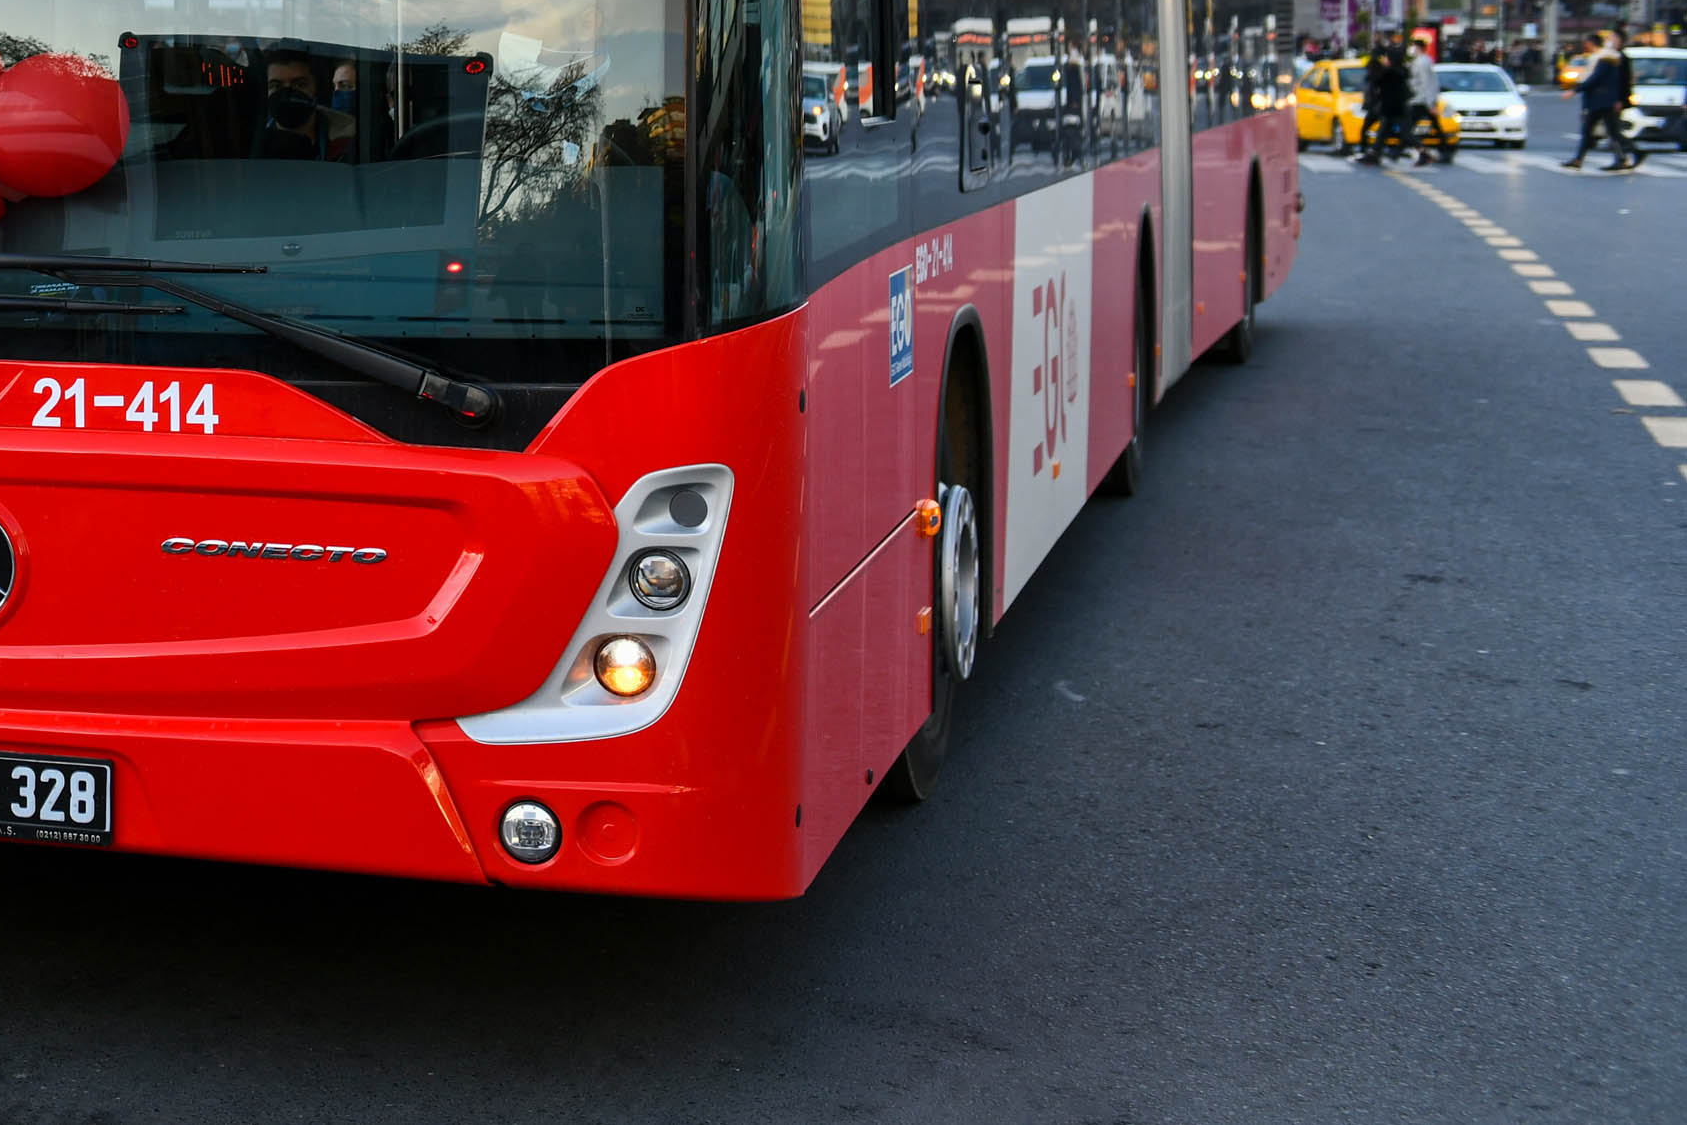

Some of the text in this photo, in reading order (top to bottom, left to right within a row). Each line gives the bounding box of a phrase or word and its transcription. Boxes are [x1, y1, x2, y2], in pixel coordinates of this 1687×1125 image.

[891, 289, 912, 357] EGO
[31, 377, 220, 435] 21-414
[161, 537, 388, 565] CONECTO
[11, 766, 96, 824] 328
[35, 829, 62, 840] (0212)
[79, 833, 89, 842] 30
[91, 834, 101, 844] 00
